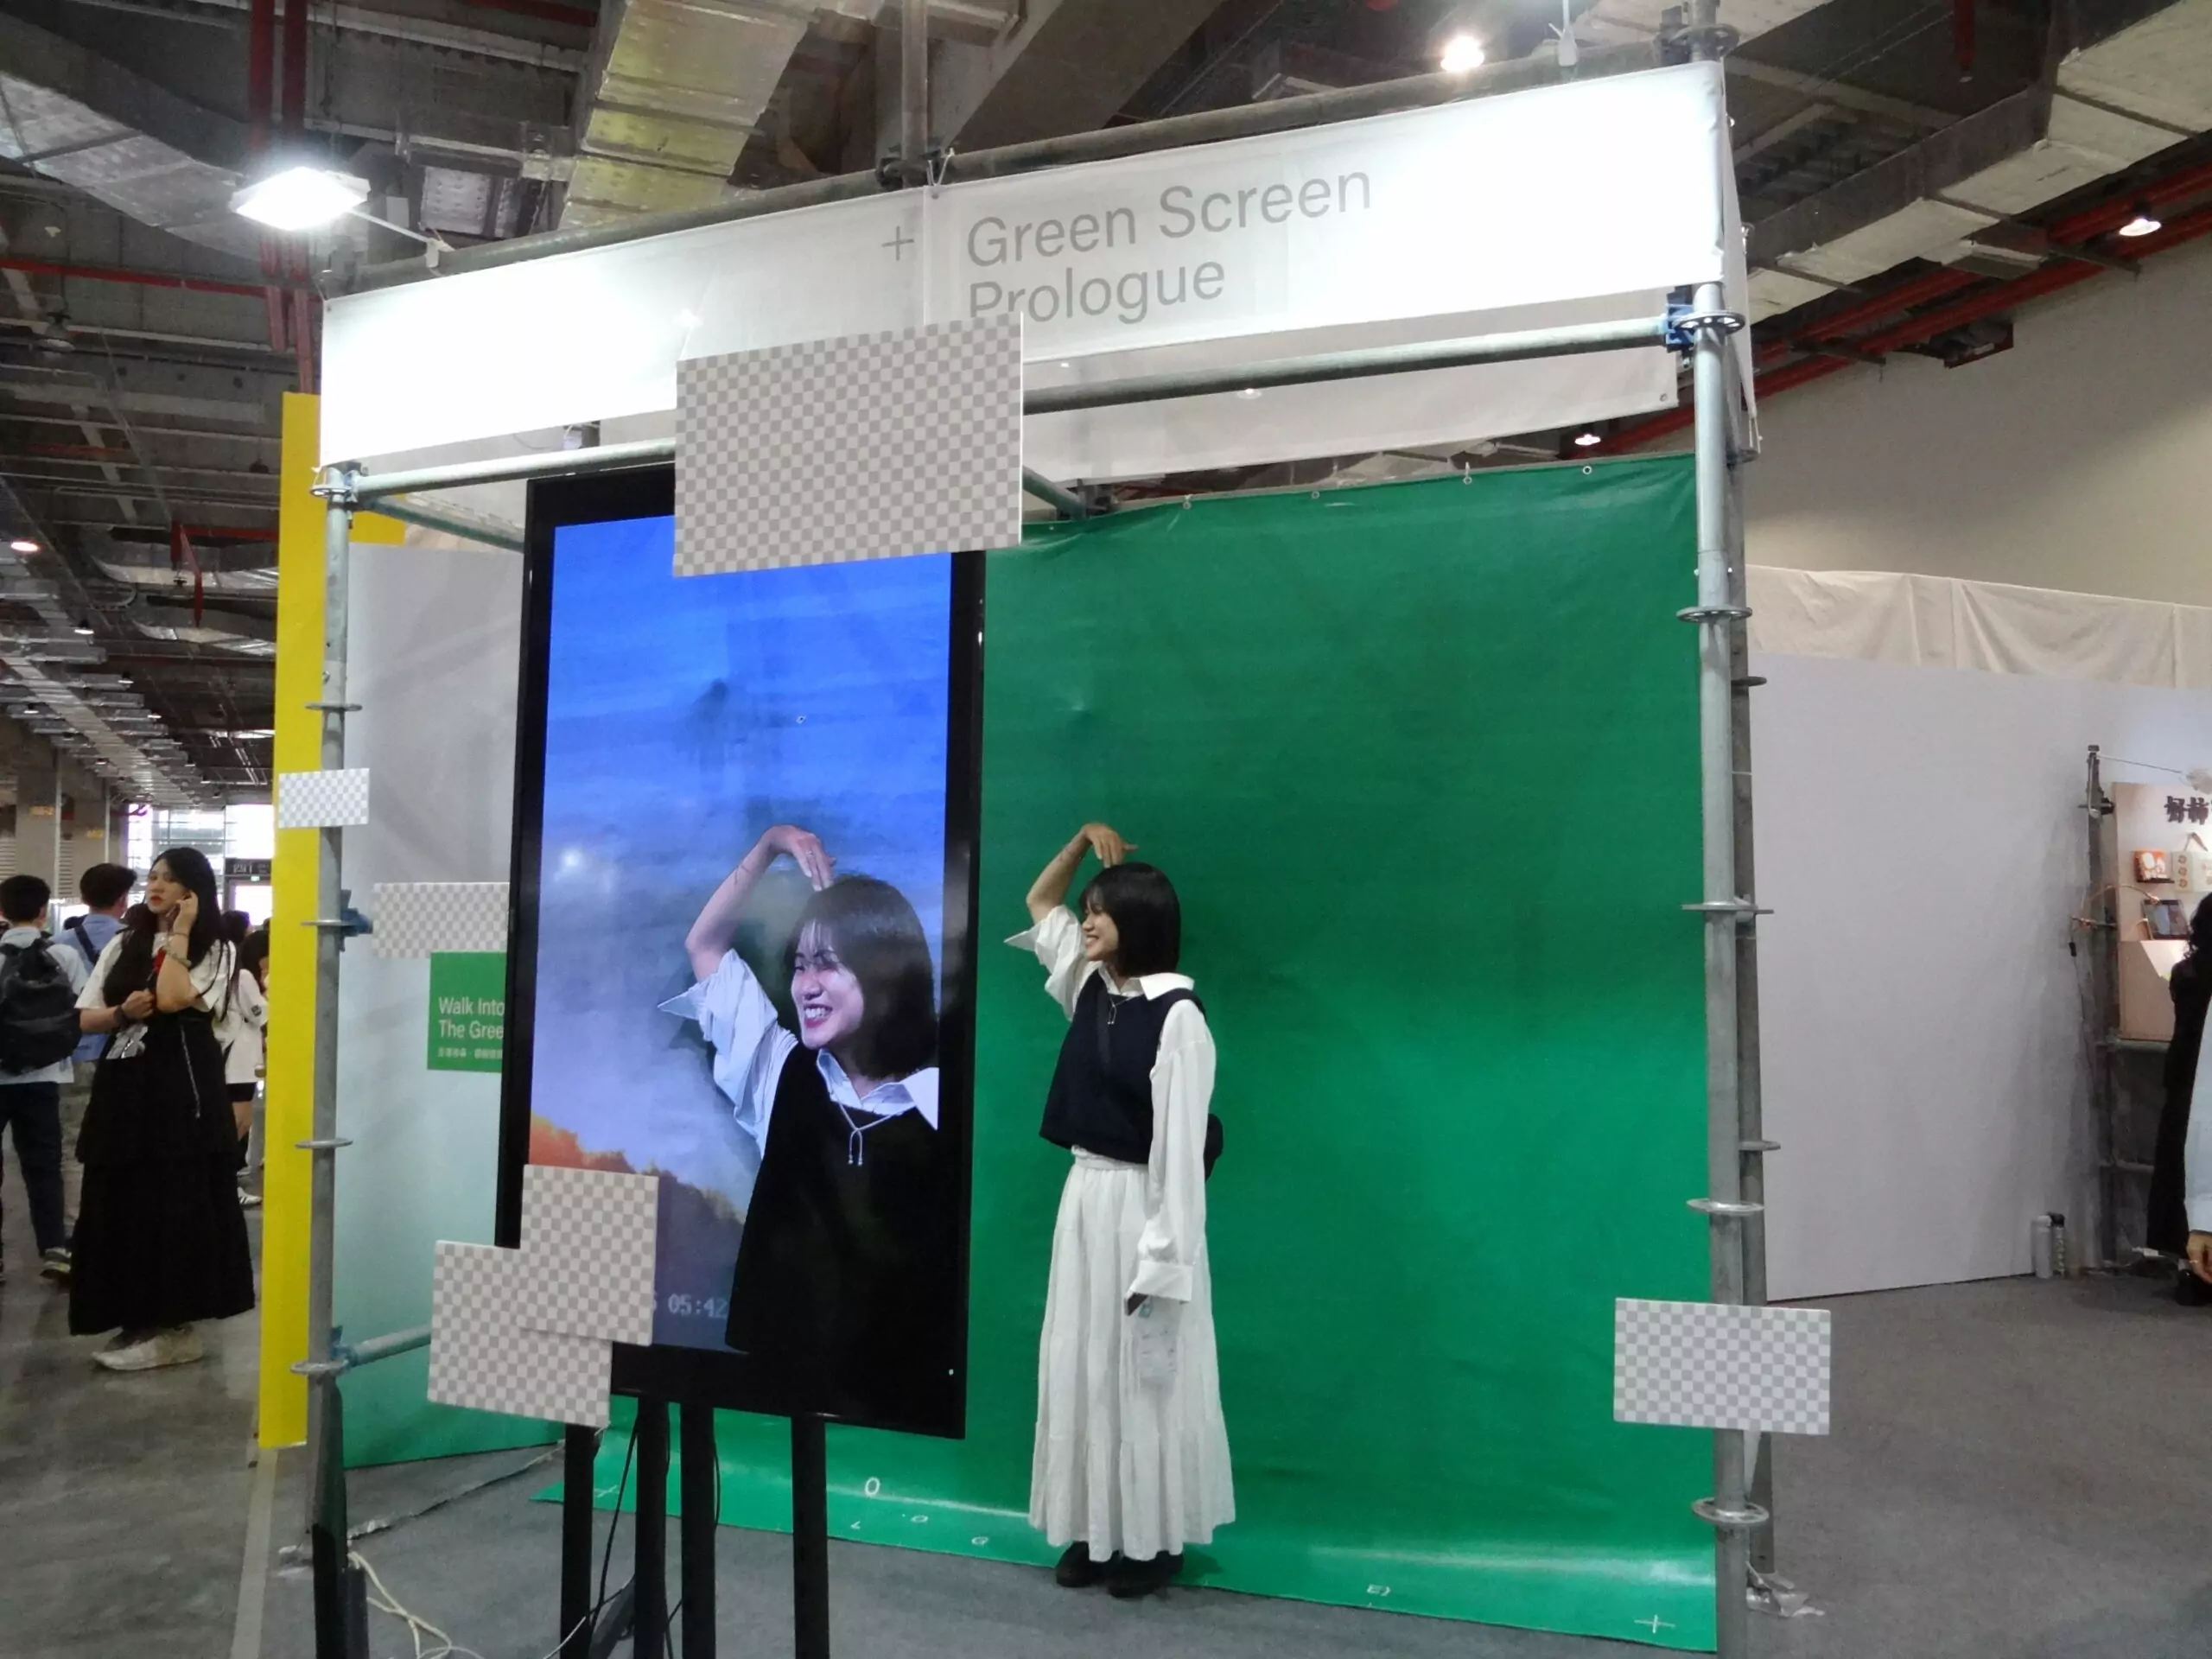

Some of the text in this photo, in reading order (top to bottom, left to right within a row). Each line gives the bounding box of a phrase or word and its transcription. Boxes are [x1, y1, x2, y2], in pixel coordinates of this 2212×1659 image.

[967, 170, 1371, 267] Green Screen
[969, 260, 1225, 325] Prologue
[439, 996, 505, 1015] Walk Into
[439, 1019, 465, 1038] The
